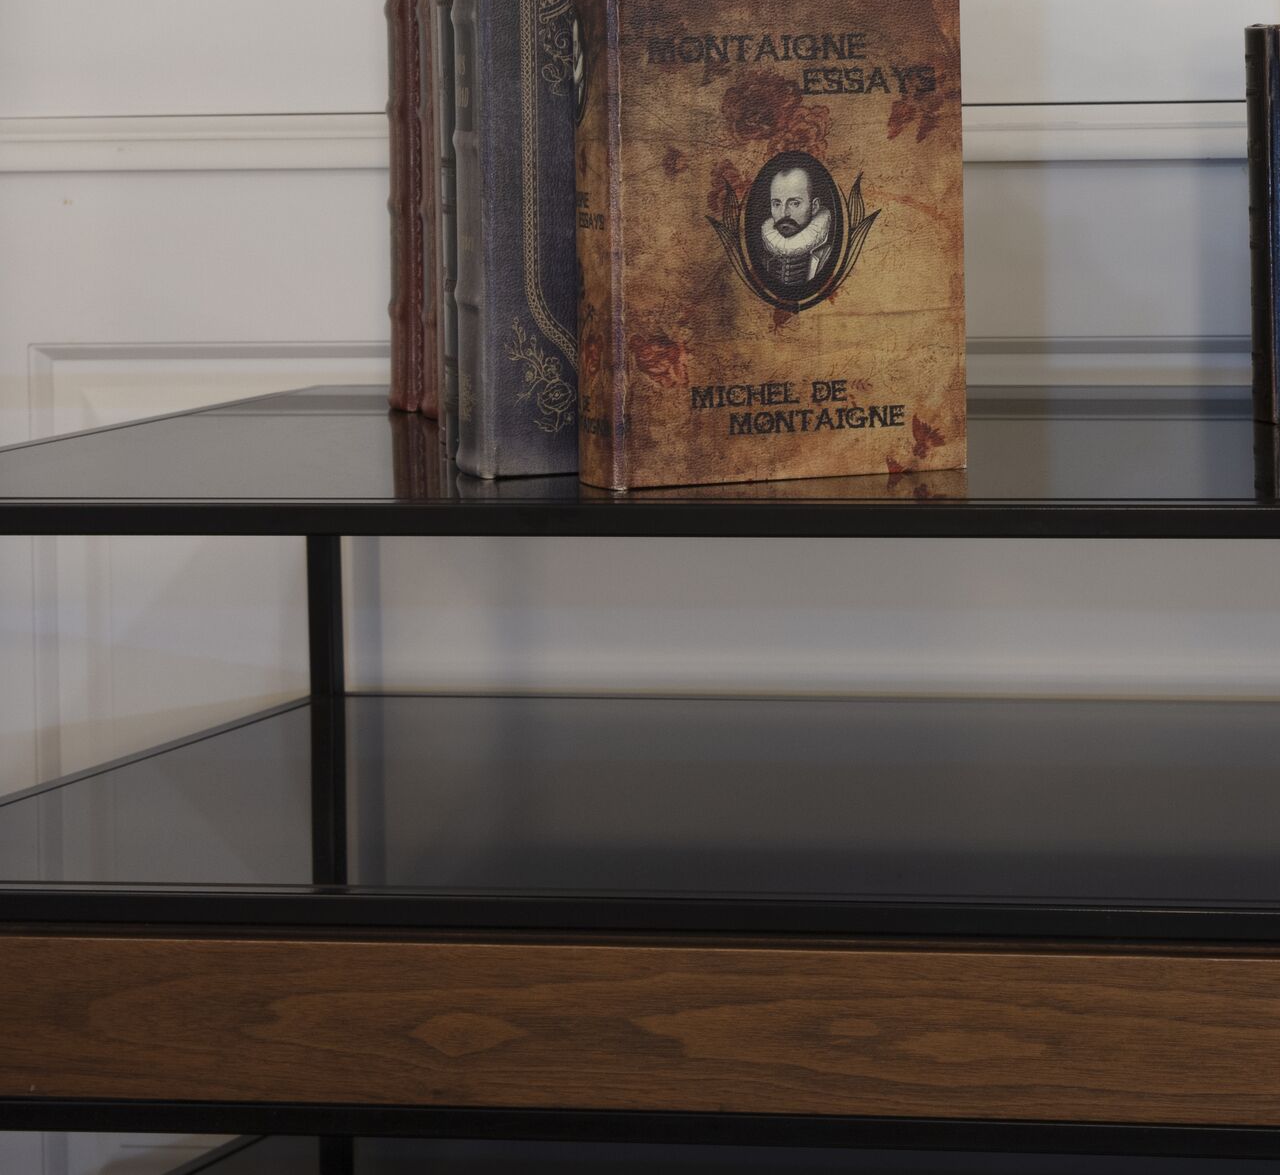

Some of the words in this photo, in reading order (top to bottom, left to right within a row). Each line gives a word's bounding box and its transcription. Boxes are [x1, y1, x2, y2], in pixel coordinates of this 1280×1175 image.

[645, 33, 868, 64] MONTAIGNE
[800, 66, 937, 95] ESSAYS
[691, 381, 800, 409] MICHEL
[811, 379, 848, 403] DE
[728, 404, 905, 436] MONTAIGNE
